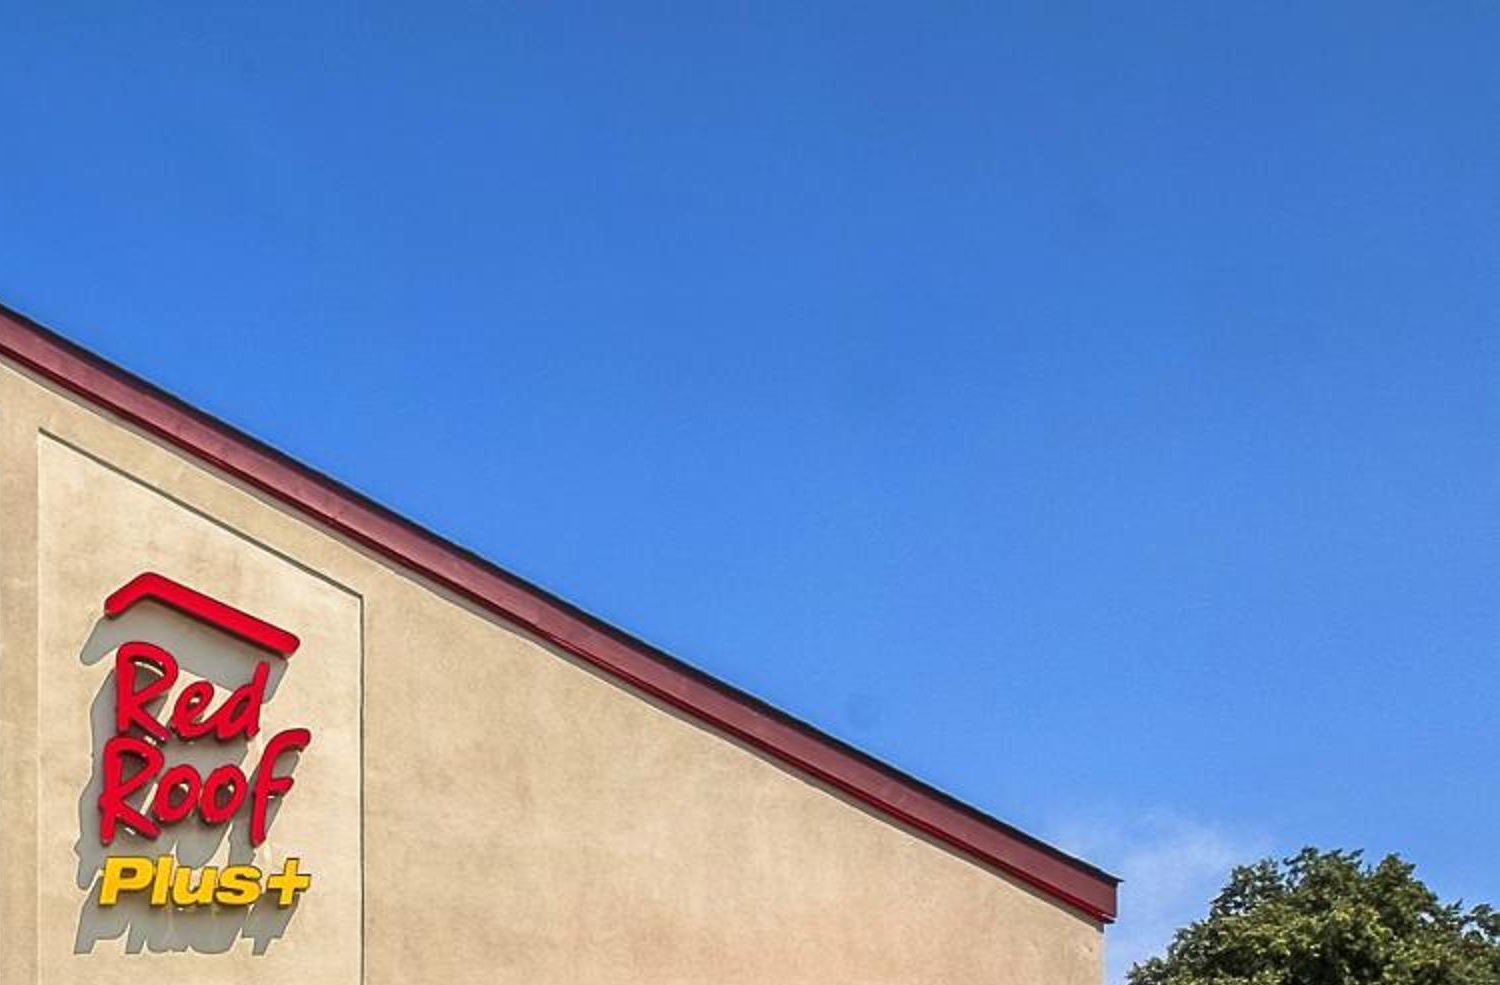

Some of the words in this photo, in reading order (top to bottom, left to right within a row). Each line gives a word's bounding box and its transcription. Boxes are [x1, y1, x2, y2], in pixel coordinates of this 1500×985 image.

[114, 640, 271, 743] Red
[97, 727, 312, 847] Roof
[99, 853, 312, 906] Plus+
